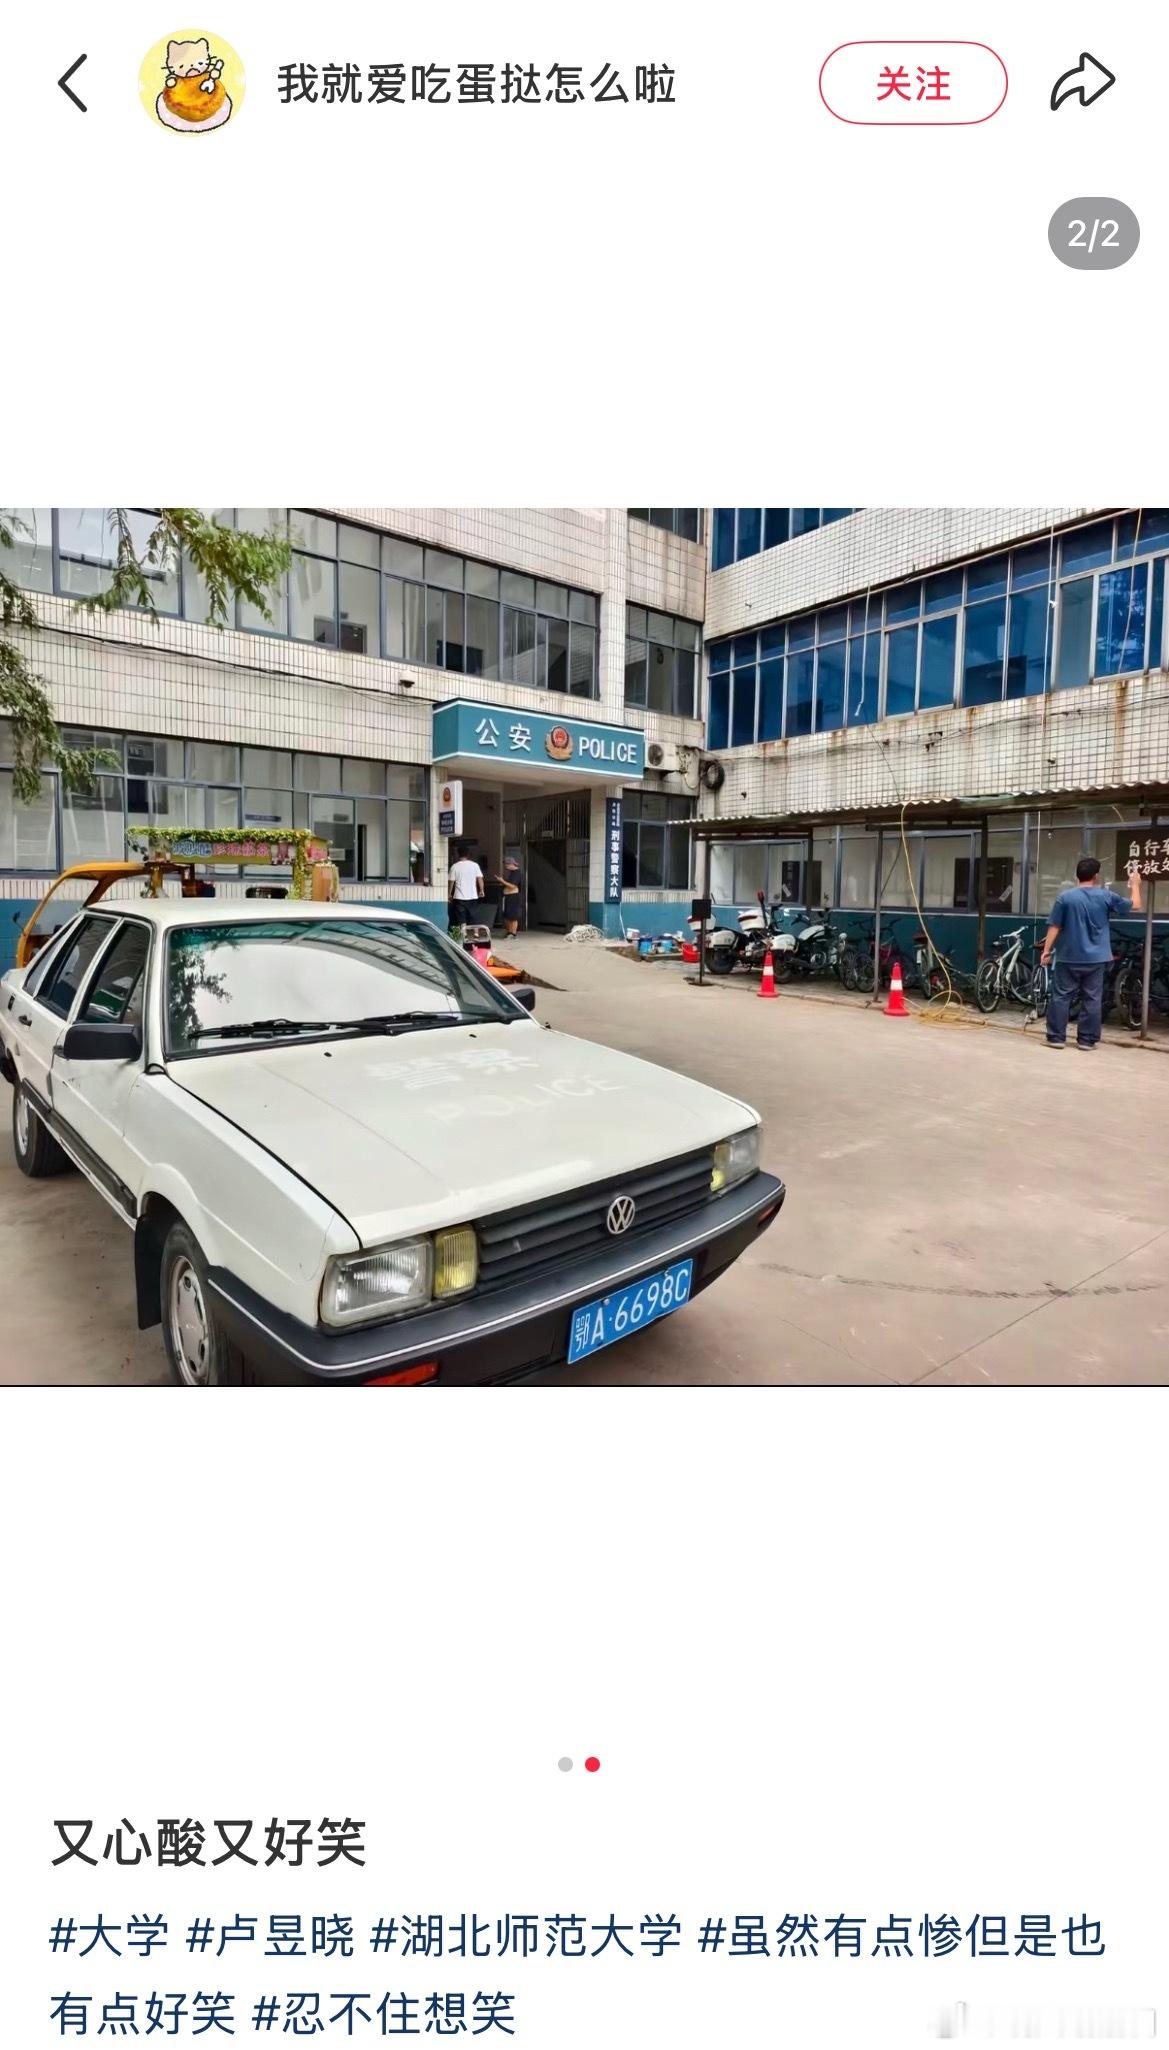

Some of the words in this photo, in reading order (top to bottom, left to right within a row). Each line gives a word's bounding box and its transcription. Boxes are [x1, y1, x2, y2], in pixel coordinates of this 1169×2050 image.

[475, 717, 532, 752] 公安
[579, 735, 638, 764] POLICE
[610, 829, 621, 898] 刑事警察大队
